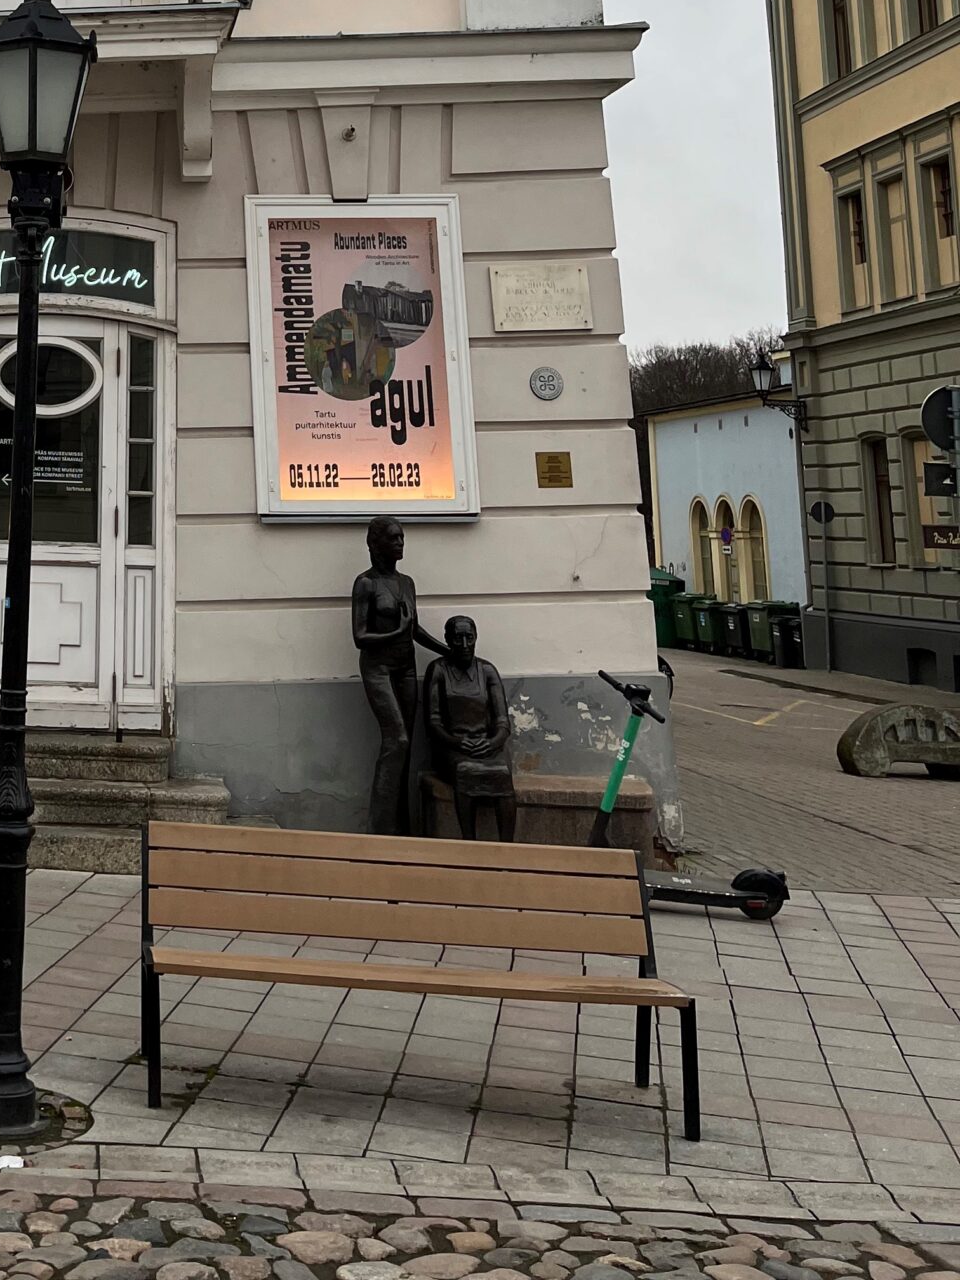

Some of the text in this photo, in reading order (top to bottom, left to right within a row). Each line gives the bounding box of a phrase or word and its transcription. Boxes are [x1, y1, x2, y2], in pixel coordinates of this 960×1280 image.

[334, 232, 407, 250] Abundant Places
[274, 241, 319, 395] Ammendamatu
[314, 410, 336, 418] Tartu
[368, 366, 435, 445] agul
[295, 422, 356, 430] puitarhitektuur
[311, 432, 342, 440] kunstis
[289, 463, 421, 488] 05.11.22 26.02.23
